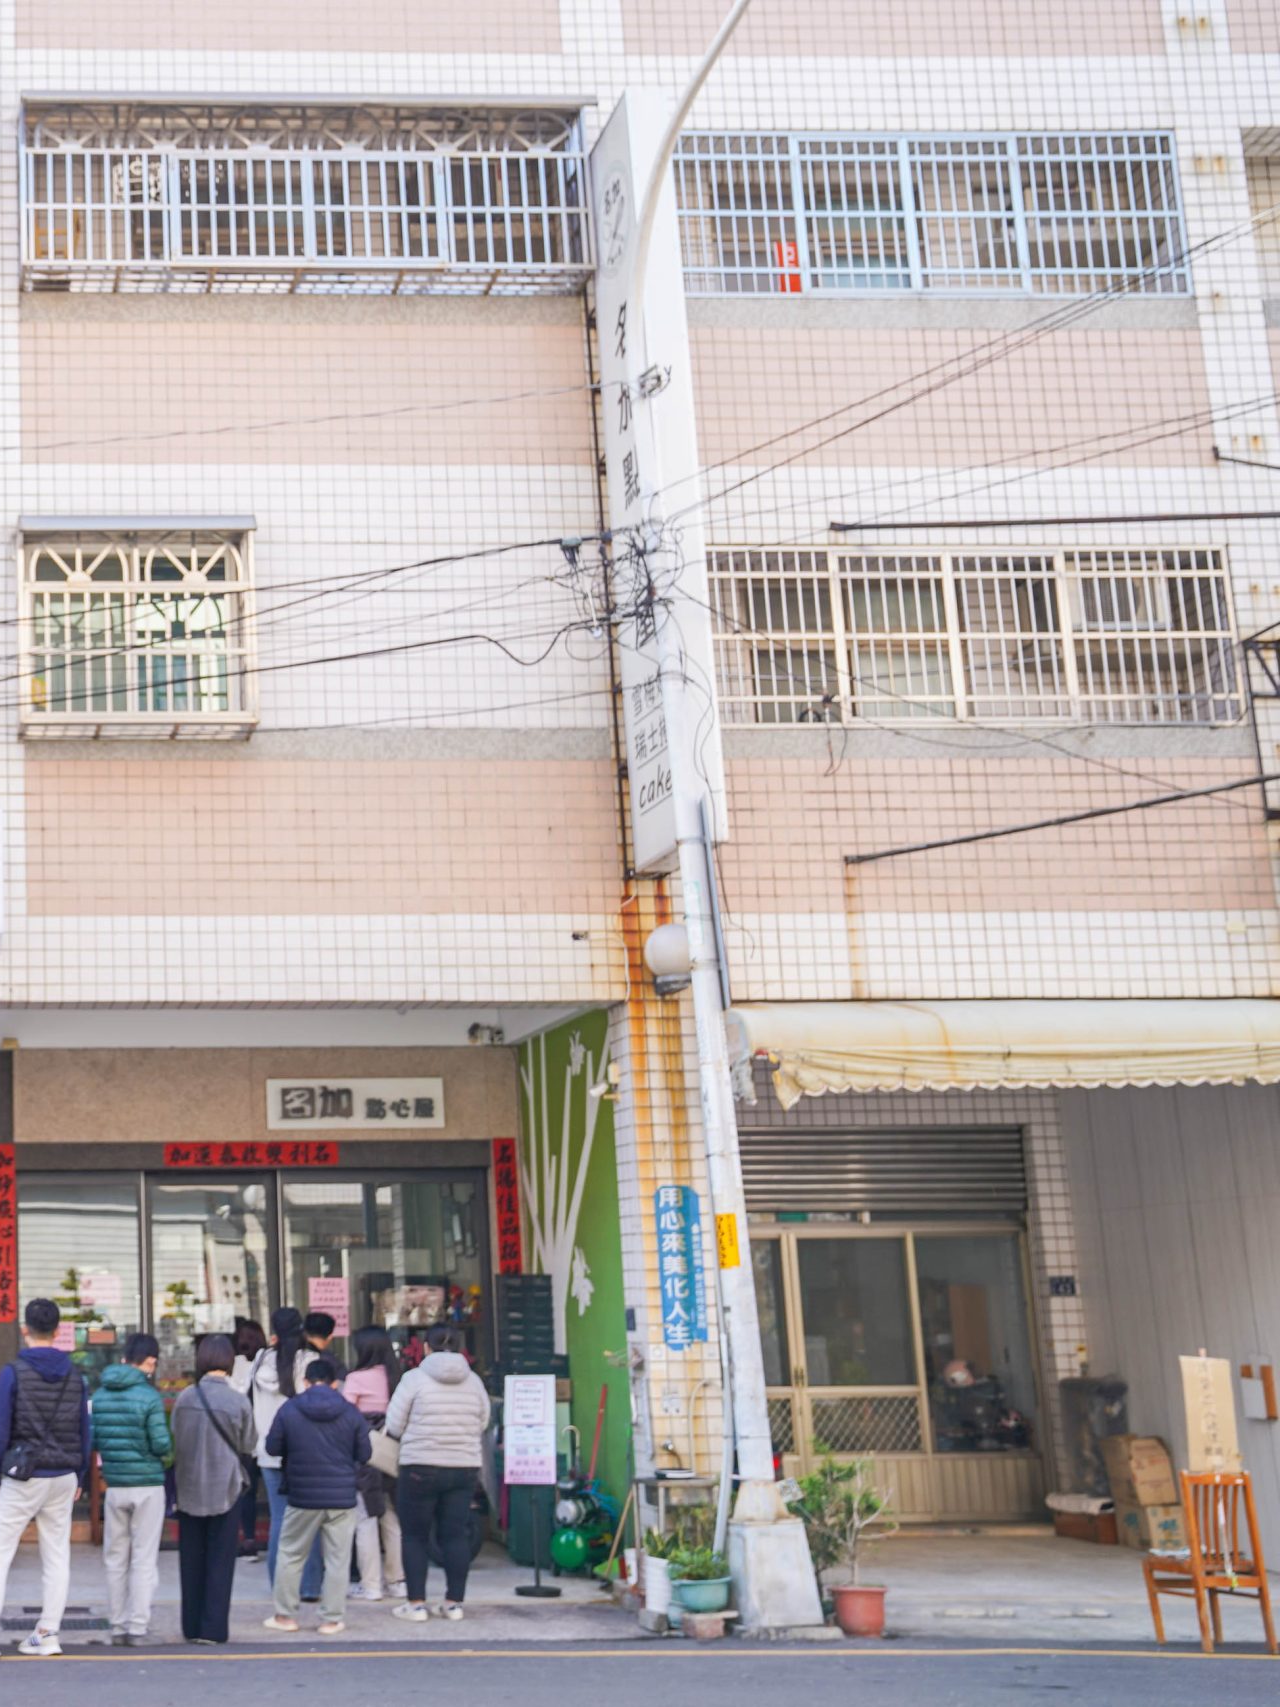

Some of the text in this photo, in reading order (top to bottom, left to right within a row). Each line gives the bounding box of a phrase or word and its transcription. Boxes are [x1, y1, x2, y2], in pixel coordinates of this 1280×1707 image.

[639, 764, 673, 808] cake
[658, 1187, 692, 1344] 用心來美化人生
